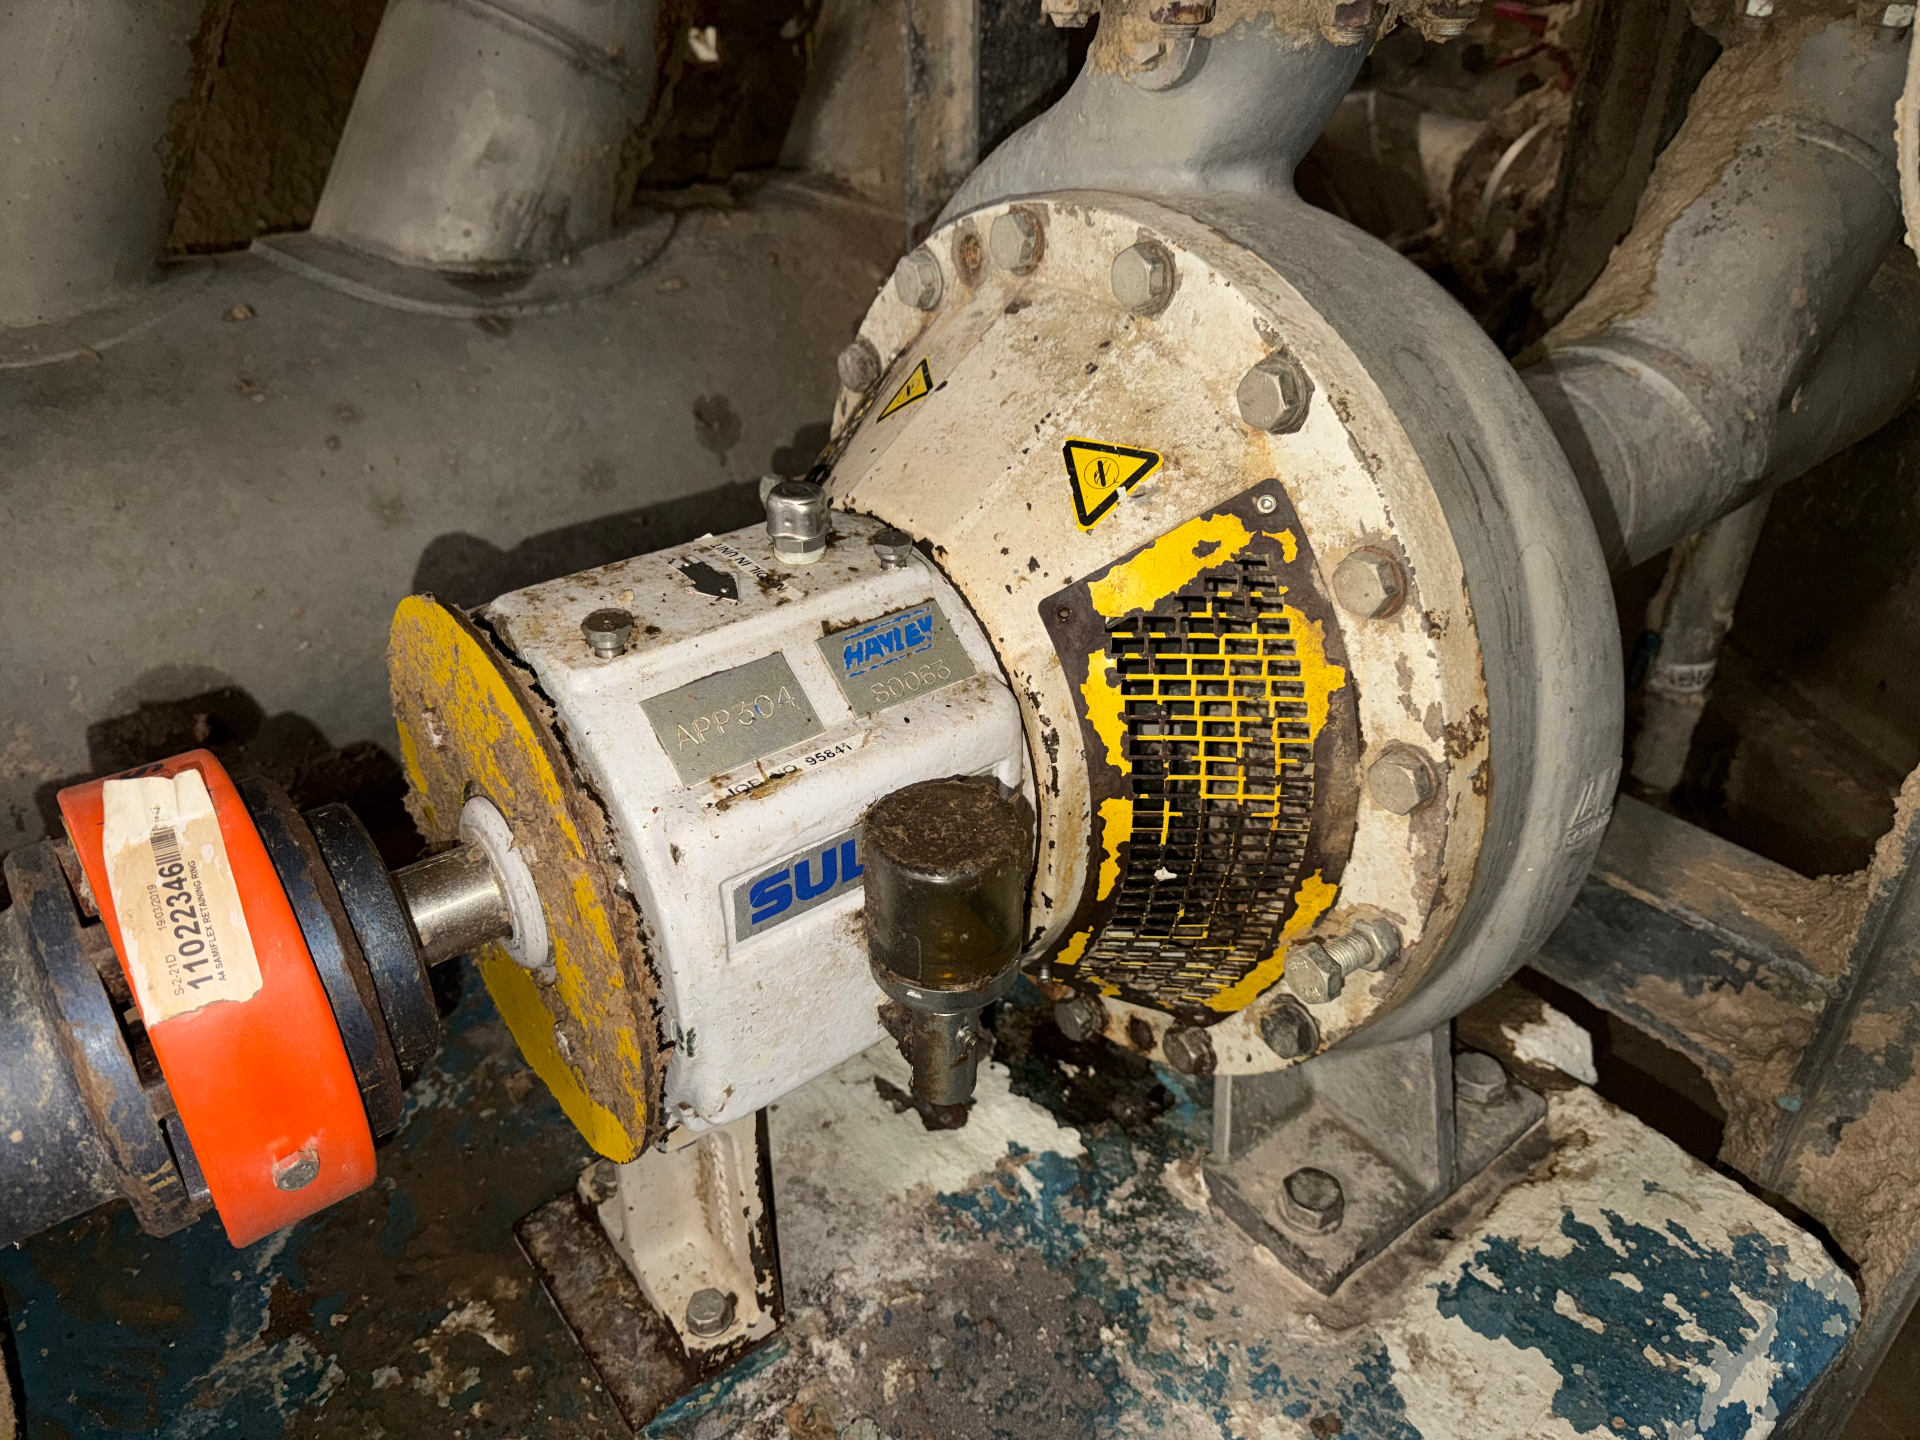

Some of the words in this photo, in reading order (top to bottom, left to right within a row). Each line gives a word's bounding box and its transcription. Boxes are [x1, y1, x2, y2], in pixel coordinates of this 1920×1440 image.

[710, 543, 738, 557] UNIT
[734, 557, 752, 567] IN
[750, 566, 769, 579] OIL
[844, 615, 933, 670] HAYLEY
[677, 686, 798, 751] APP304
[769, 765, 797, 779] O
[805, 742, 853, 765] 95841
[187, 860, 200, 880] RING
[147, 884, 167, 932] 19/03/2019
[193, 880, 211, 924] RETAINING
[158, 862, 213, 990] 11022346
[204, 924, 224, 970] SAMIFLEX
[165, 954, 185, 996] S-2-21D
[217, 970, 227, 981] A4
